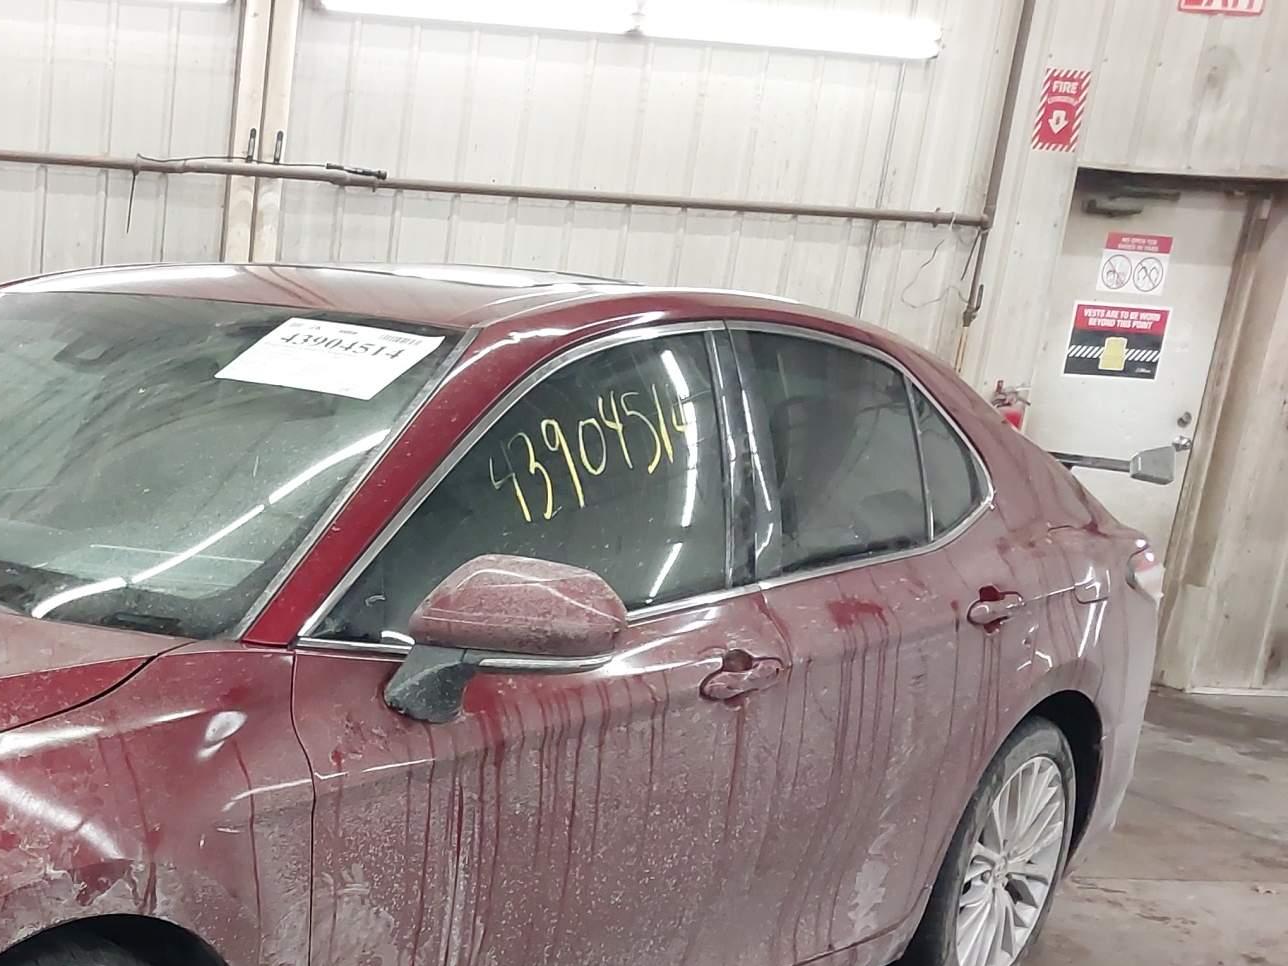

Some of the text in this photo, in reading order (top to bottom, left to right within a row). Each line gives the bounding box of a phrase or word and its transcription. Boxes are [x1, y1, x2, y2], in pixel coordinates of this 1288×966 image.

[1052, 80, 1079, 94] FIRE
[1083, 308, 1105, 317] VESTS
[1105, 310, 1118, 318] ARE
[1120, 310, 1129, 319] TO
[1087, 317, 1153, 329] BEYOND THIS POINT
[280, 333, 405, 359] 43904514
[489, 384, 692, 522] 43904514
